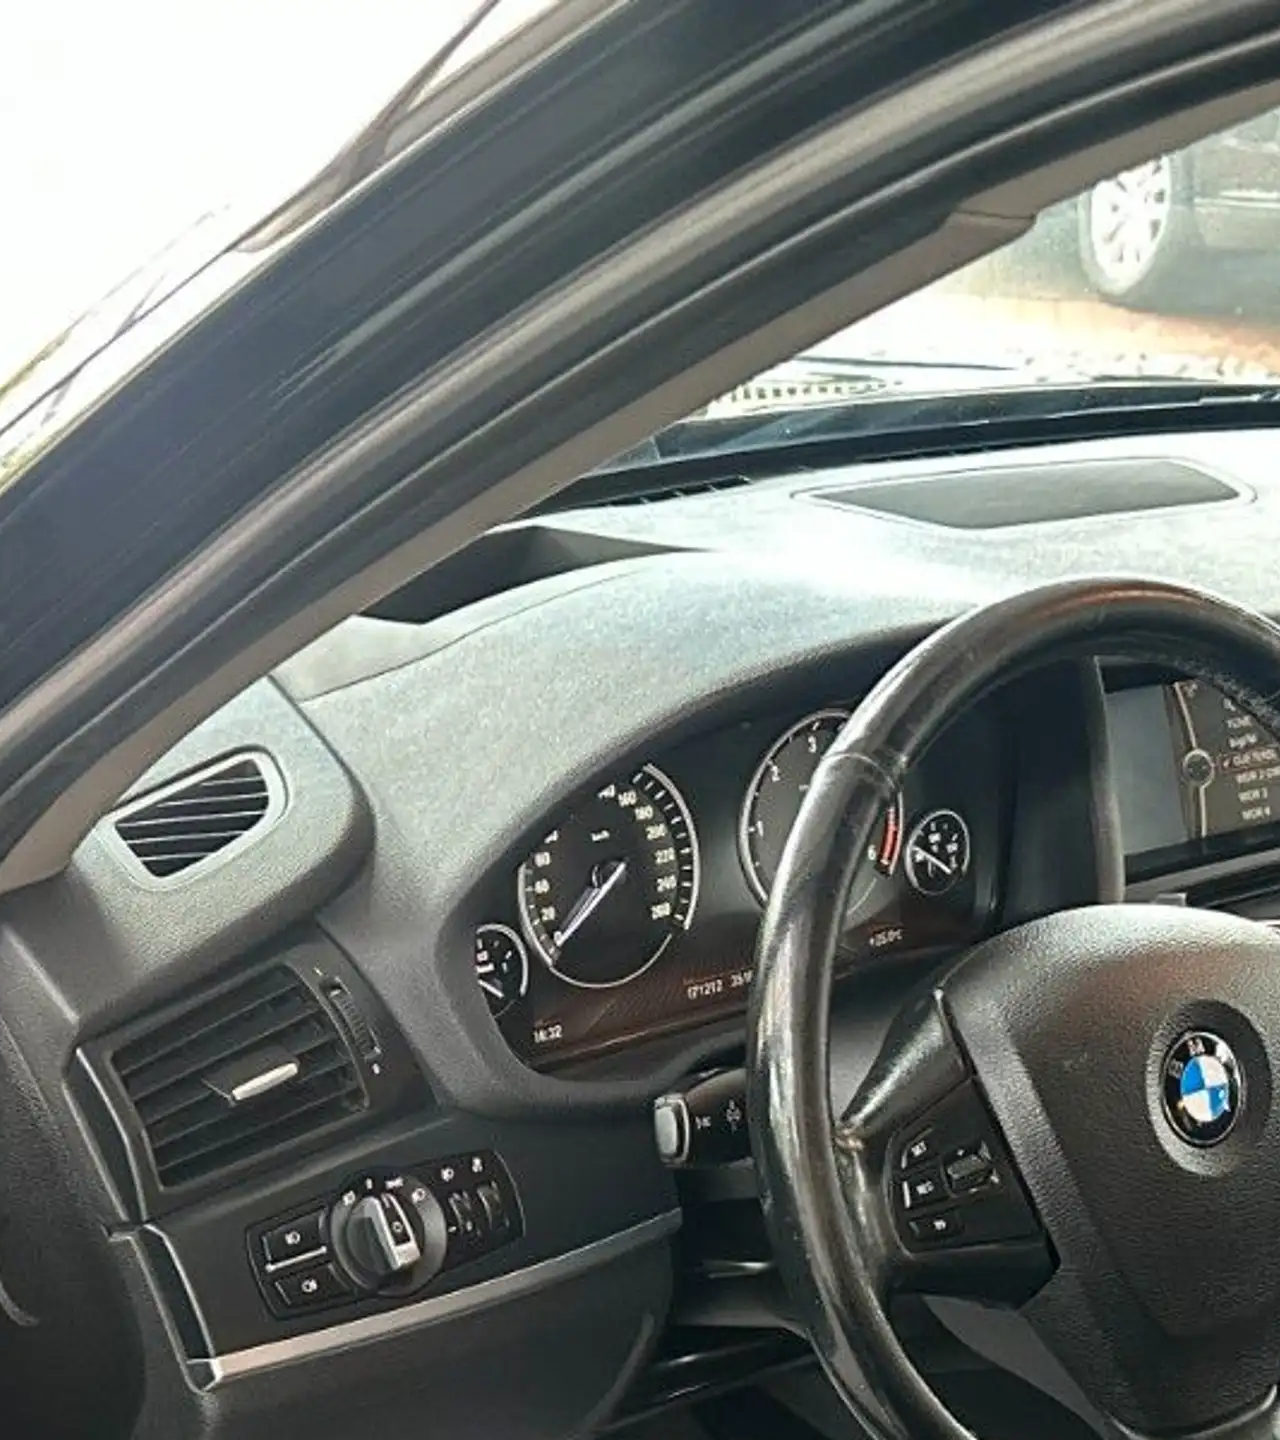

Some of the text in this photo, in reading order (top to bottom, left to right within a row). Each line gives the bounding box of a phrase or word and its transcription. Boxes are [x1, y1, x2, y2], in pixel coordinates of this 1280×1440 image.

[807, 735, 817, 753] 3
[770, 764, 781, 782] 2
[867, 844, 877, 861] 6
